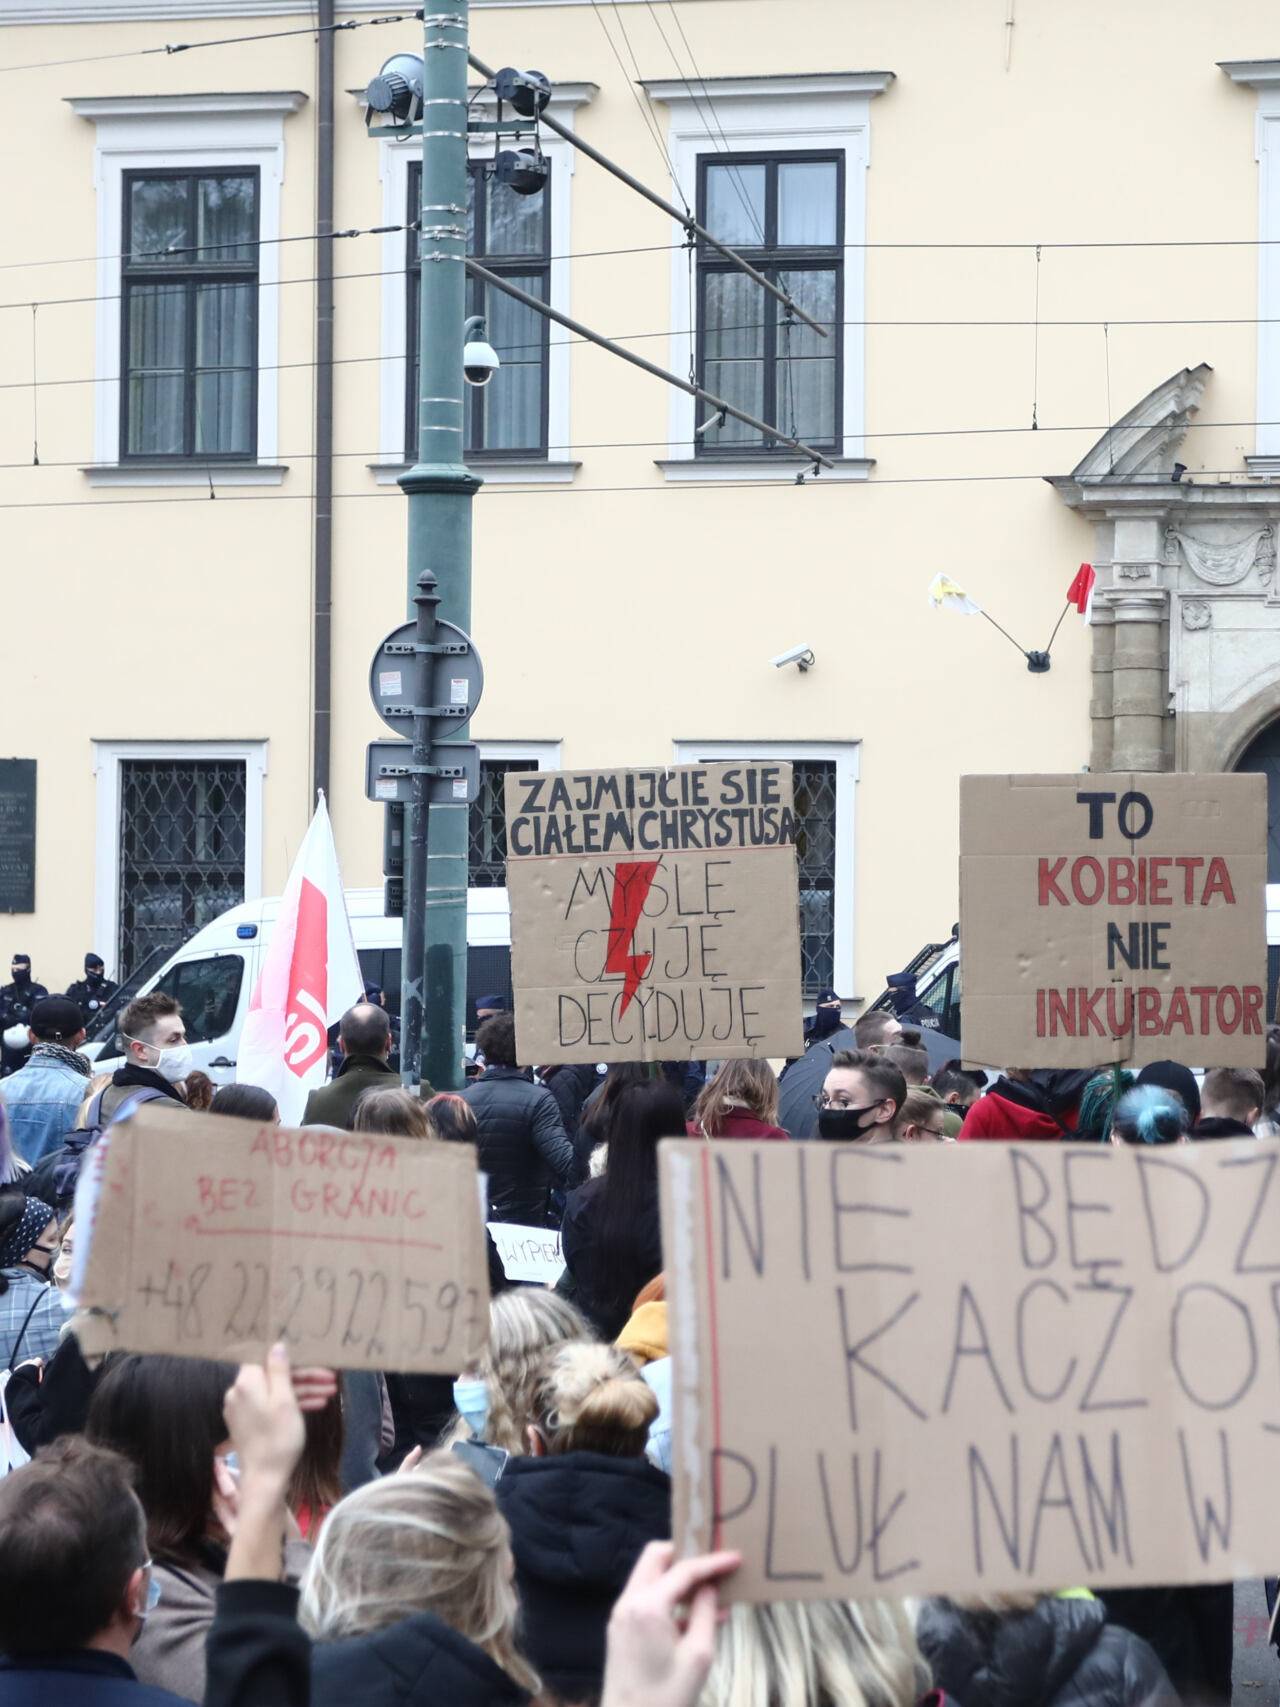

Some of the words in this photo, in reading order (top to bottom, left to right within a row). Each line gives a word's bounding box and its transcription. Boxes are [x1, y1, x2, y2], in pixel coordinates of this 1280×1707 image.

[519, 770, 709, 814] ZAJMIJCIE
[1076, 791, 1154, 840] TO
[511, 810, 634, 856] CIAŁEM
[637, 806, 795, 850] CHRYSTUSA
[564, 853, 736, 920] MYŚLĘ
[1037, 855, 1236, 906] KOBIETA
[574, 925, 728, 983] CZUJĘ
[1106, 921, 1171, 971] NIE
[558, 986, 766, 1047] DECYDUJĘ
[1036, 985, 1264, 1037] INKUBATOR
[251, 1127, 399, 1182] ABORCJA
[197, 1176, 258, 1216] BEZ
[290, 1177, 427, 1220] GRANIC
[714, 1147, 914, 1282] NIE
[711, 1445, 921, 1583] PLUŁ
[969, 1431, 1133, 1575] NAM
[1178, 1428, 1235, 1560] W
